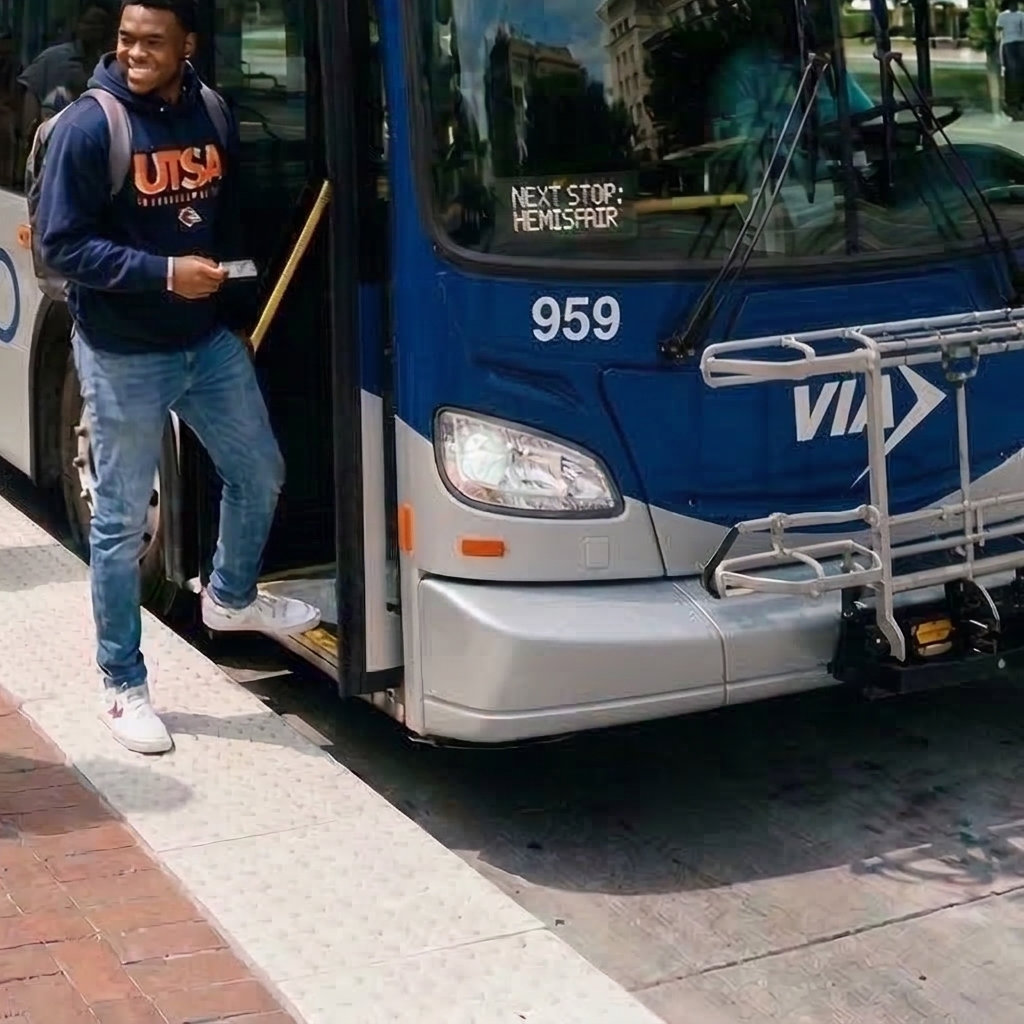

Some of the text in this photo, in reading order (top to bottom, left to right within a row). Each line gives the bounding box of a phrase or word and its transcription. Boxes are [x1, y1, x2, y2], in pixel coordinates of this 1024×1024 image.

[133, 143, 223, 195] UTSA
[511, 182, 624, 209] NEXT STOP:
[513, 206, 619, 232] HEMISFAIR
[531, 295, 621, 342] 959
[793, 373, 895, 442] VIA
